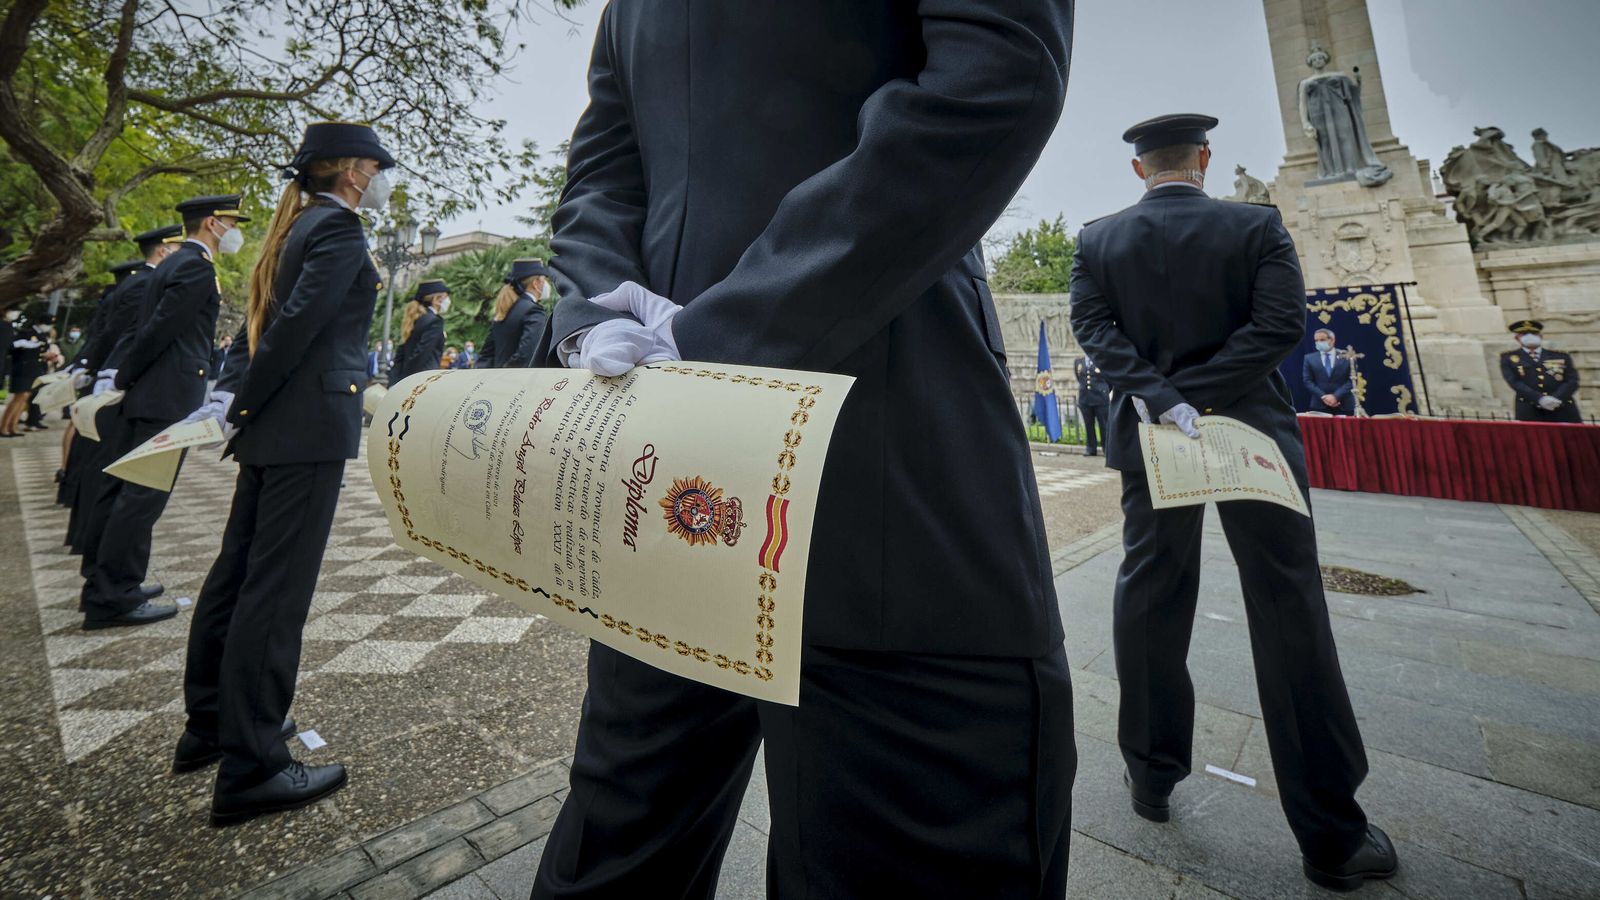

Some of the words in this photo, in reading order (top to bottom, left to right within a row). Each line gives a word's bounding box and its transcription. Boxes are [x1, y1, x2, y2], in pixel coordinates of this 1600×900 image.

[583, 374, 599, 392] cala
[621, 373, 639, 393] como
[452, 396, 471, 423] Antonio
[529, 397, 556, 430] Pedro
[584, 383, 619, 431] formación
[625, 394, 637, 407] La
[490, 410, 511, 452] Provincial
[551, 392, 585, 443] Ejecutiva,
[591, 395, 623, 451] testimonio
[488, 452, 496, 462] de
[500, 437, 507, 448] de
[515, 430, 535, 475] Ángel
[549, 447, 557, 456] a
[577, 437, 588, 452] de
[495, 448, 504, 480] Febrero
[586, 453, 595, 464] y
[554, 448, 571, 511] Promoción
[567, 454, 581, 514] prácticas
[580, 467, 593, 520] recuerdo
[623, 443, 659, 552] Diploma
[592, 481, 606, 547] Provincial
[510, 520, 524, 555] López
[553, 521, 562, 555] XXXII
[566, 520, 576, 570] realizado
[579, 527, 589, 541] de
[579, 543, 586, 556] su
[592, 550, 601, 563] de
[554, 563, 564, 576] de
[556, 576, 565, 586] la
[567, 579, 574, 591] en
